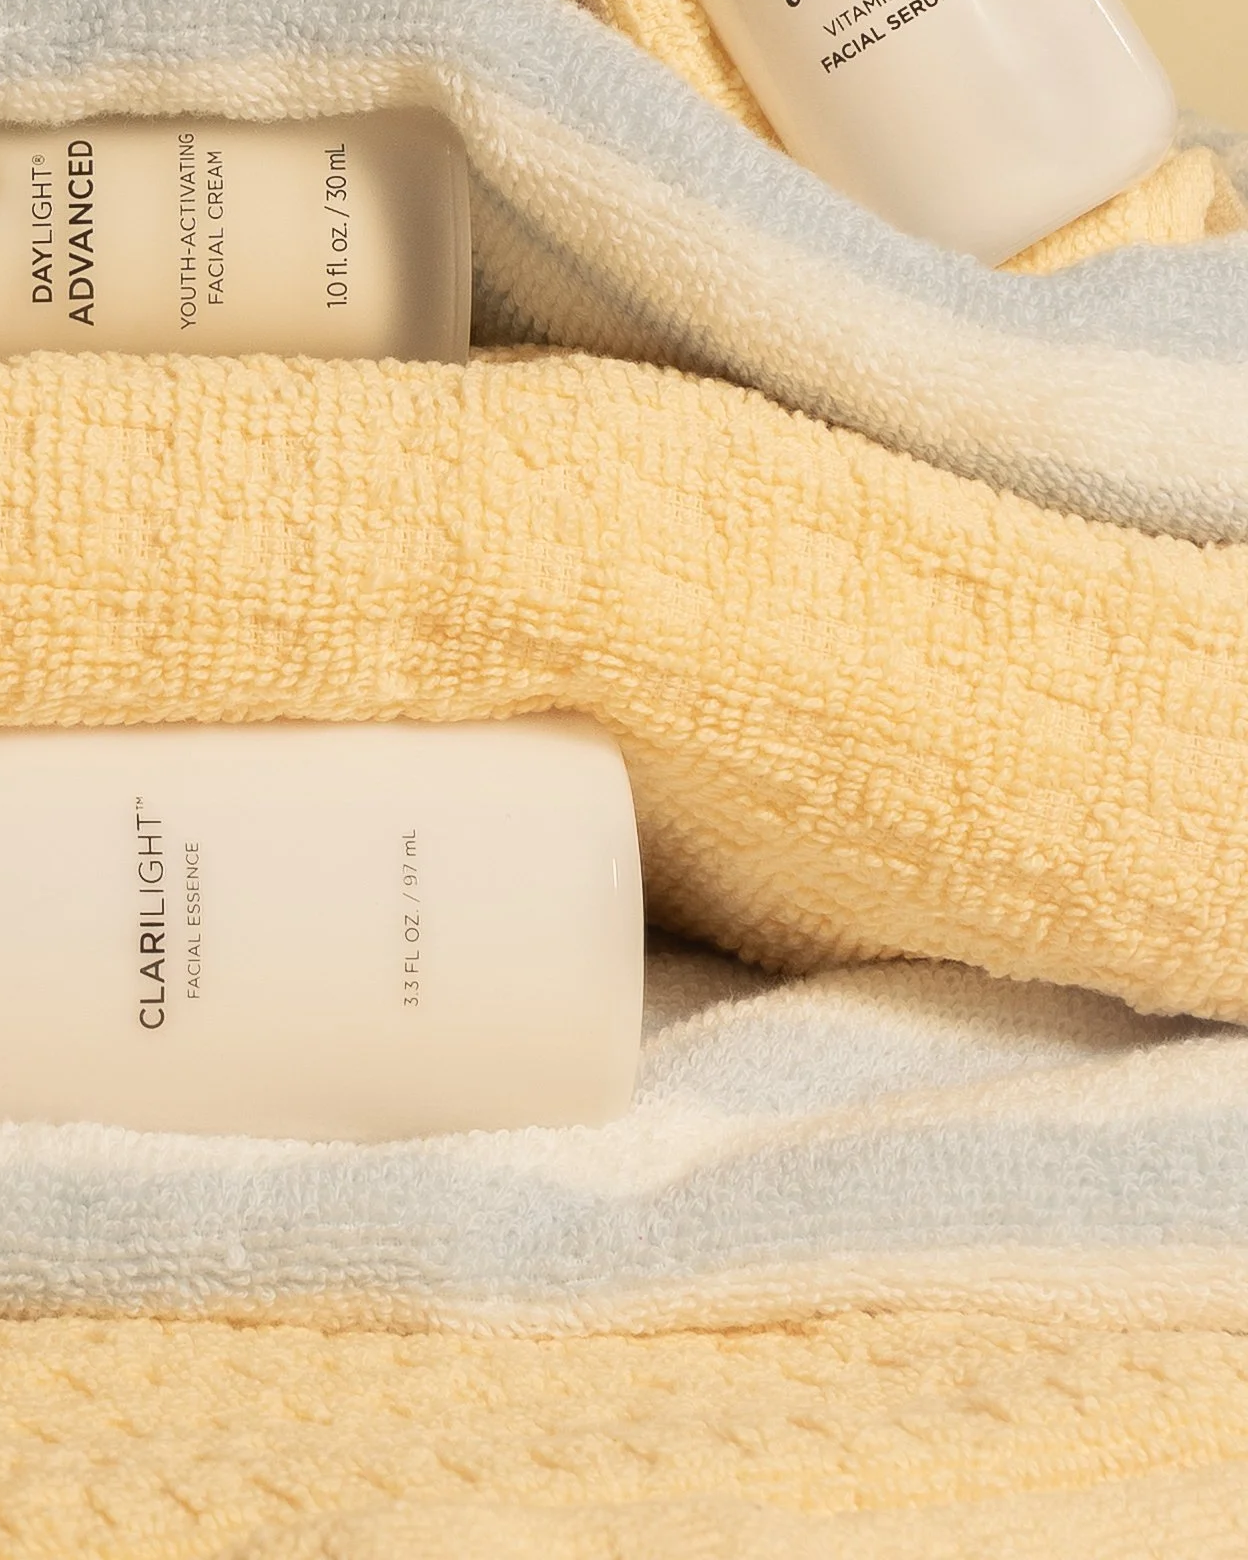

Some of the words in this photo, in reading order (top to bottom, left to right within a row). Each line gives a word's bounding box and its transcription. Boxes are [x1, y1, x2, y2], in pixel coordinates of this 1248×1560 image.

[821, 25, 886, 73] FACIAL
[324, 143, 345, 169] mL
[207, 151, 223, 219] CREAM
[325, 175, 346, 201] 30
[324, 205, 349, 217] /
[67, 139, 94, 325] ADVANCED
[178, 133, 196, 329] YOUTH-ACTIVATING
[331, 222, 347, 251] oz.
[208, 227, 223, 304] FACIAL
[326, 258, 347, 276] fl.
[326, 282, 347, 307] 1.0
[402, 829, 415, 855] mL
[185, 842, 200, 925] ESSENCE
[402, 864, 417, 885] 97
[402, 892, 420, 902] /
[404, 909, 419, 941] OZ.
[187, 933, 200, 998] FACIAL
[404, 950, 419, 972] FL
[404, 980, 418, 1006] 3.3
